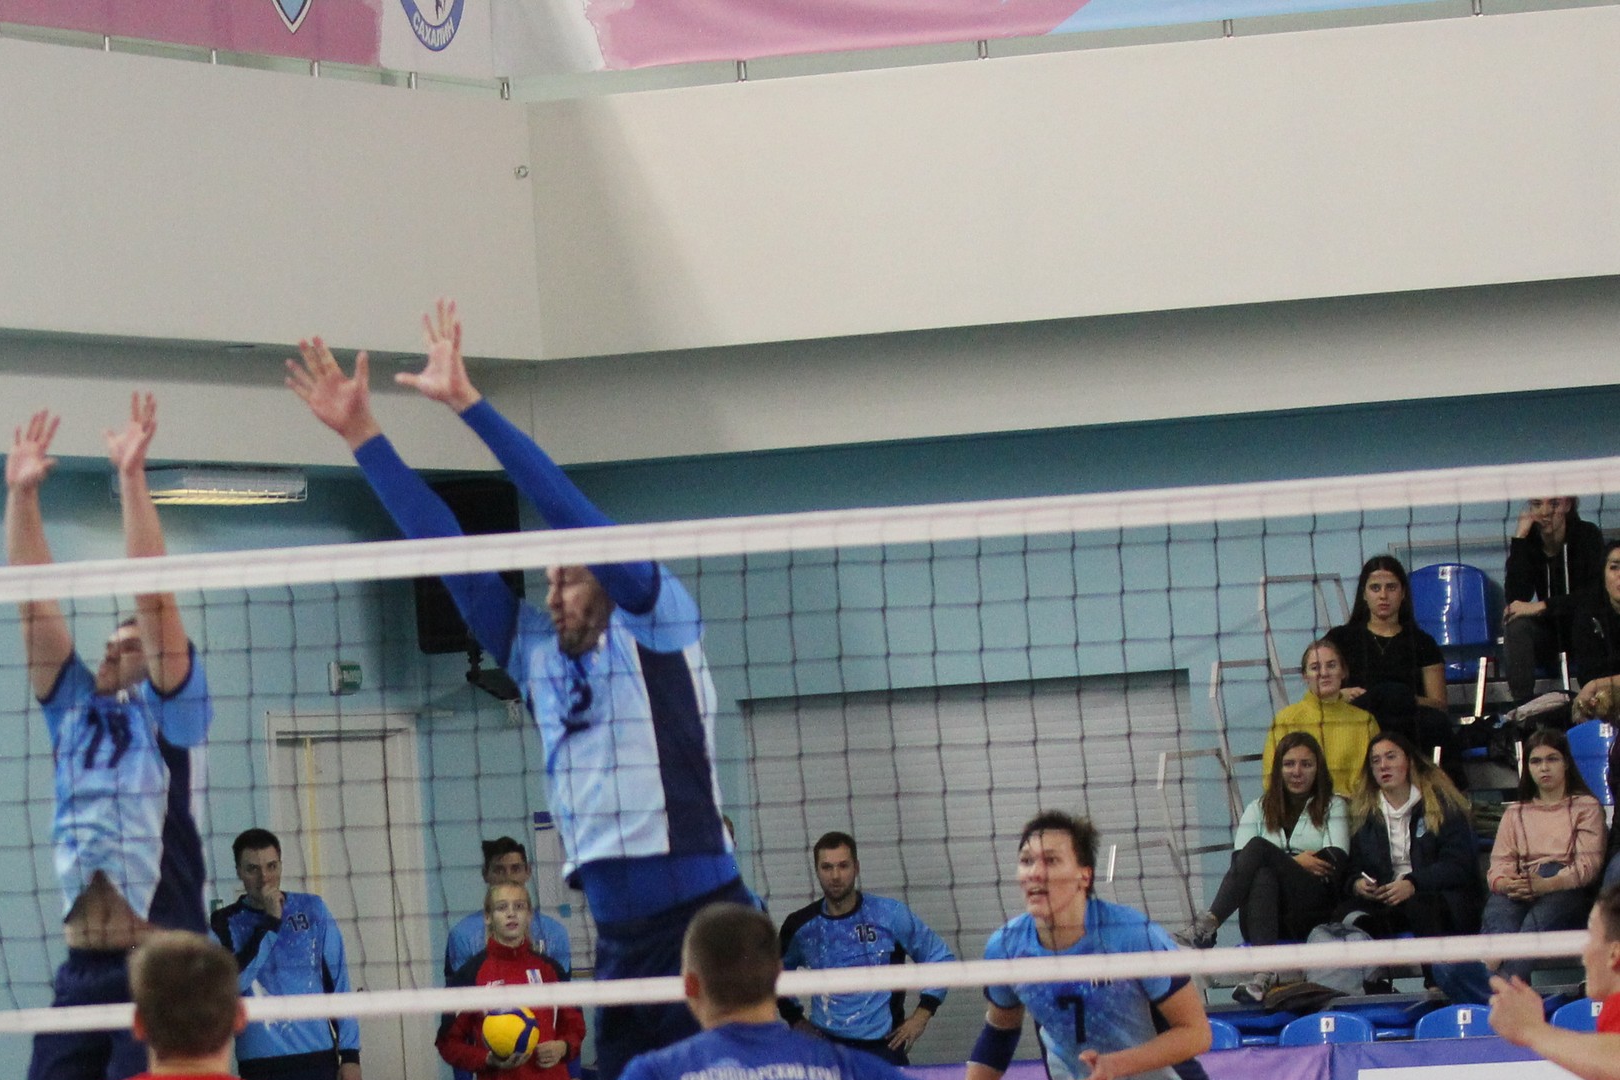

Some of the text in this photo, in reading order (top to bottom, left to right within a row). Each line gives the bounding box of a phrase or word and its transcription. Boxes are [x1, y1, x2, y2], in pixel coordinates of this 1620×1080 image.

[413, 11, 455, 47] САХАЛИН
[287, 912, 310, 932] 13
[855, 923, 878, 944] 15
[1056, 994, 1087, 1044] 7
